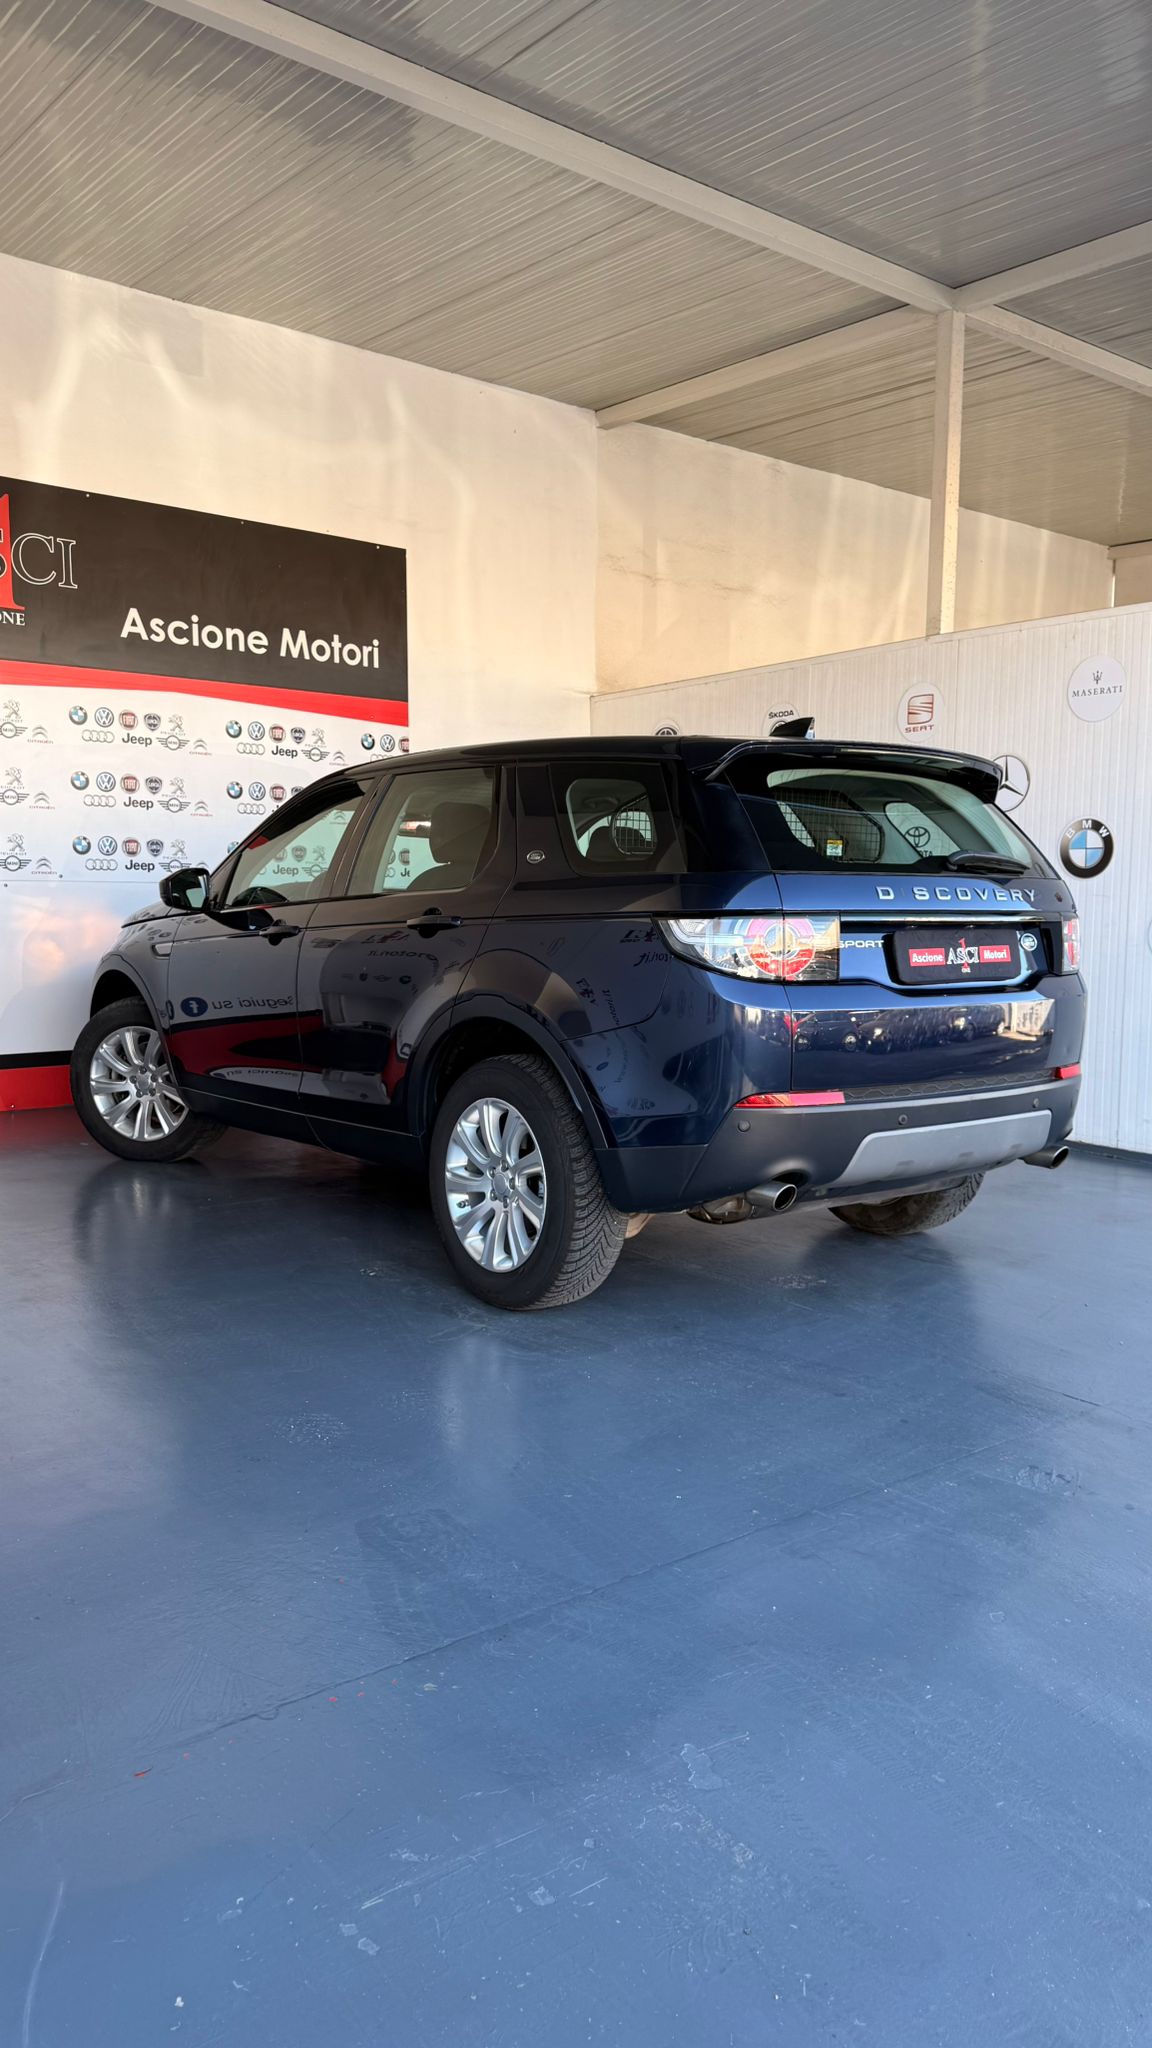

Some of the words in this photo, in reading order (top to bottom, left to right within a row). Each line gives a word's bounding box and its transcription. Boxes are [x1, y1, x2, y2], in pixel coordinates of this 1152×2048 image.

[0, 610, 25, 626] NE
[120, 607, 268, 654] Ascione
[280, 628, 380, 668] Motori
[1072, 685, 1123, 698] MASERATI
[768, 709, 795, 719] ŠKODA
[904, 724, 935, 734] SEAT
[122, 733, 153, 747] Jeep
[271, 745, 298, 758] Jeep
[123, 797, 154, 810] Jeep
[1065, 819, 1110, 839] BMW
[125, 860, 155, 873] Jeep
[272, 865, 299, 877] Jeep
[839, 940, 884, 948] SPORT
[912, 952, 944, 963] Ascione
[947, 947, 979, 965] ASCI
[983, 948, 1008, 960] Motori
